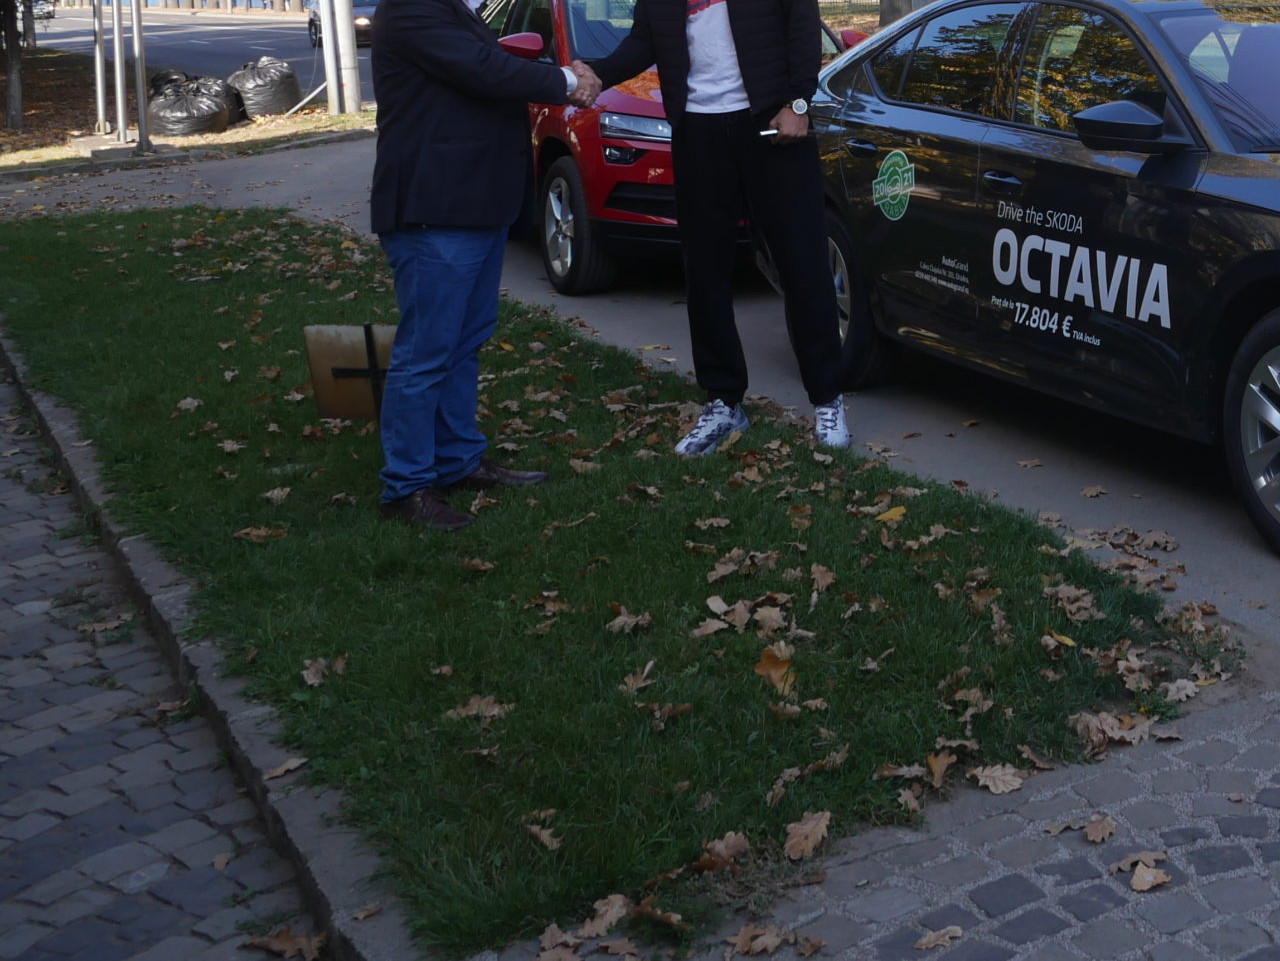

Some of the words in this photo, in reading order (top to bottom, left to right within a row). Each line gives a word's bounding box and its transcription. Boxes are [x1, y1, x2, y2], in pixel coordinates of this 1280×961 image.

[875, 182, 885, 198] 20
[903, 171, 913, 186] 21
[997, 200, 1023, 222] Drive
[1025, 206, 1043, 226] the
[1045, 210, 1083, 234] SKODA
[992, 228, 1171, 329] OCTAVIA
[1014, 302, 1059, 333] 17.804
[1062, 315, 1074, 338] €
[1072, 330, 1083, 342] TVA
[1083, 334, 1101, 346] inclus
